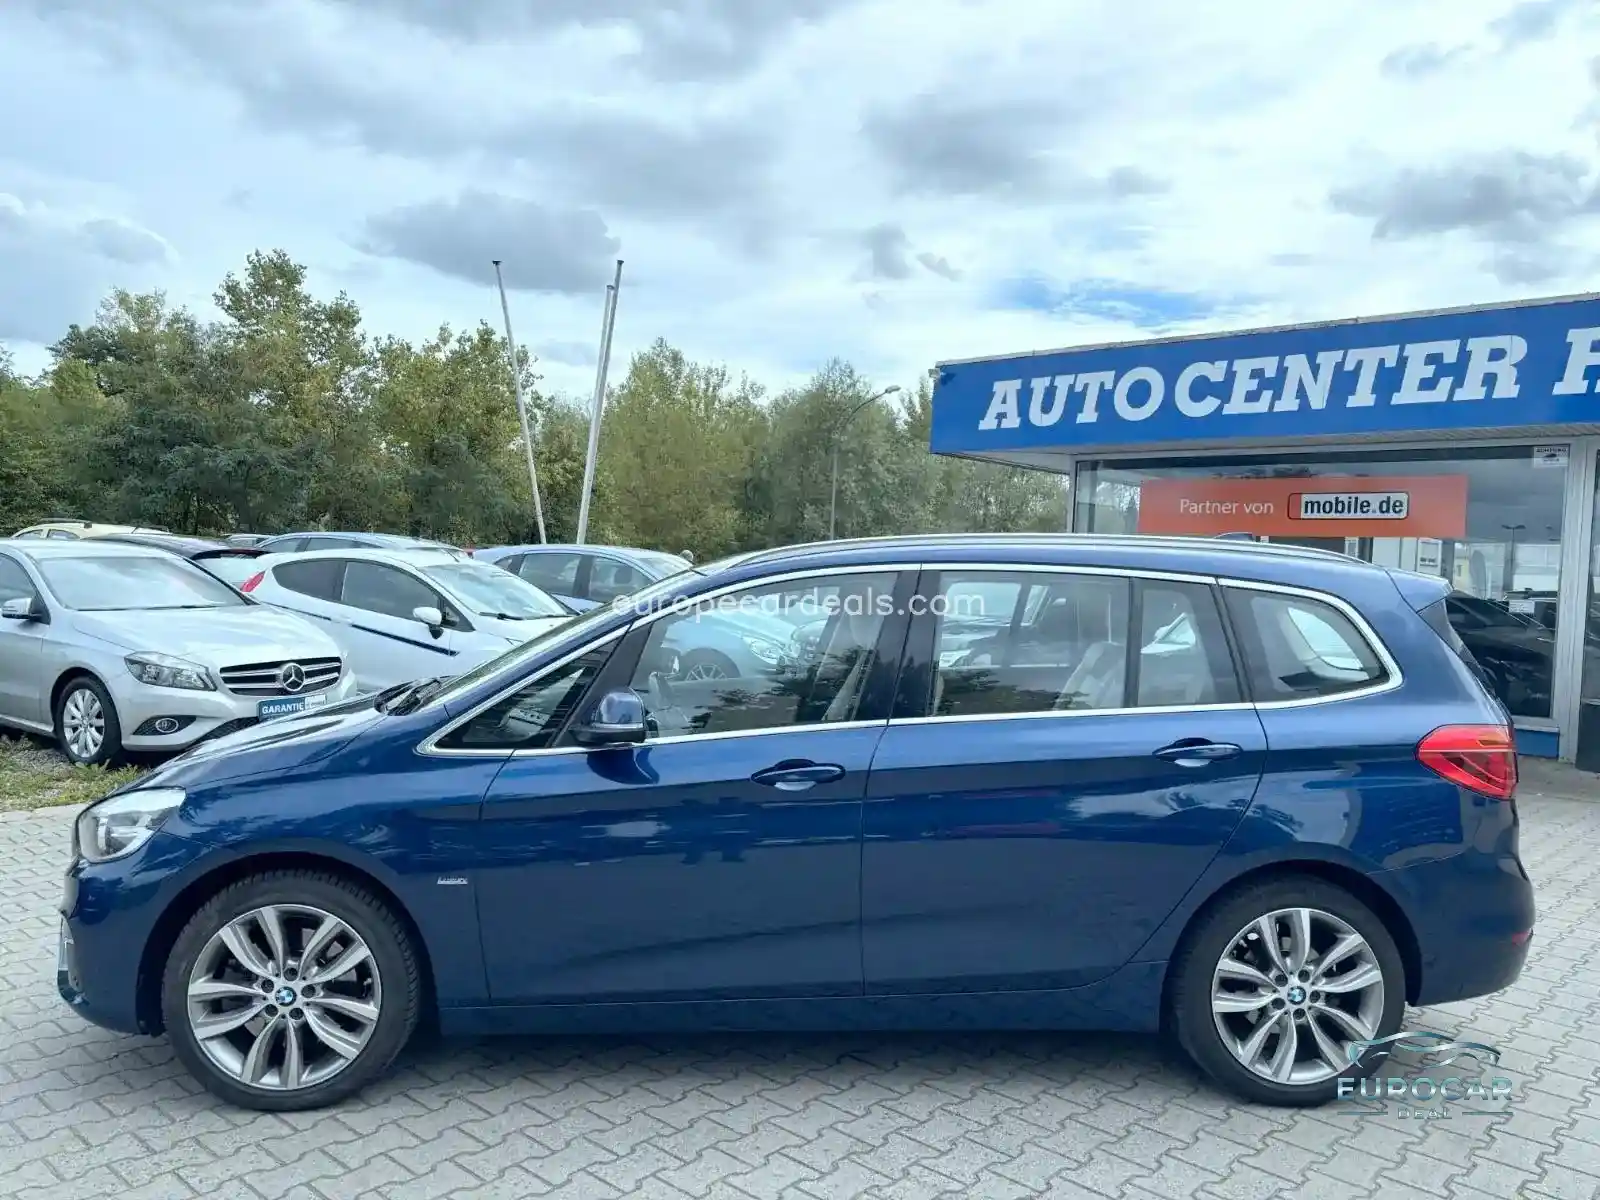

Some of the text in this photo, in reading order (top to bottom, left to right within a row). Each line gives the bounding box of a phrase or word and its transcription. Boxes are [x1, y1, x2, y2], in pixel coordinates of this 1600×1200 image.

[978, 366, 1165, 431] AUTO
[1174, 334, 1528, 418] CENTER
[1180, 495, 1404, 515] Partner von mobile.de
[261, 702, 305, 714] GARANTIE
